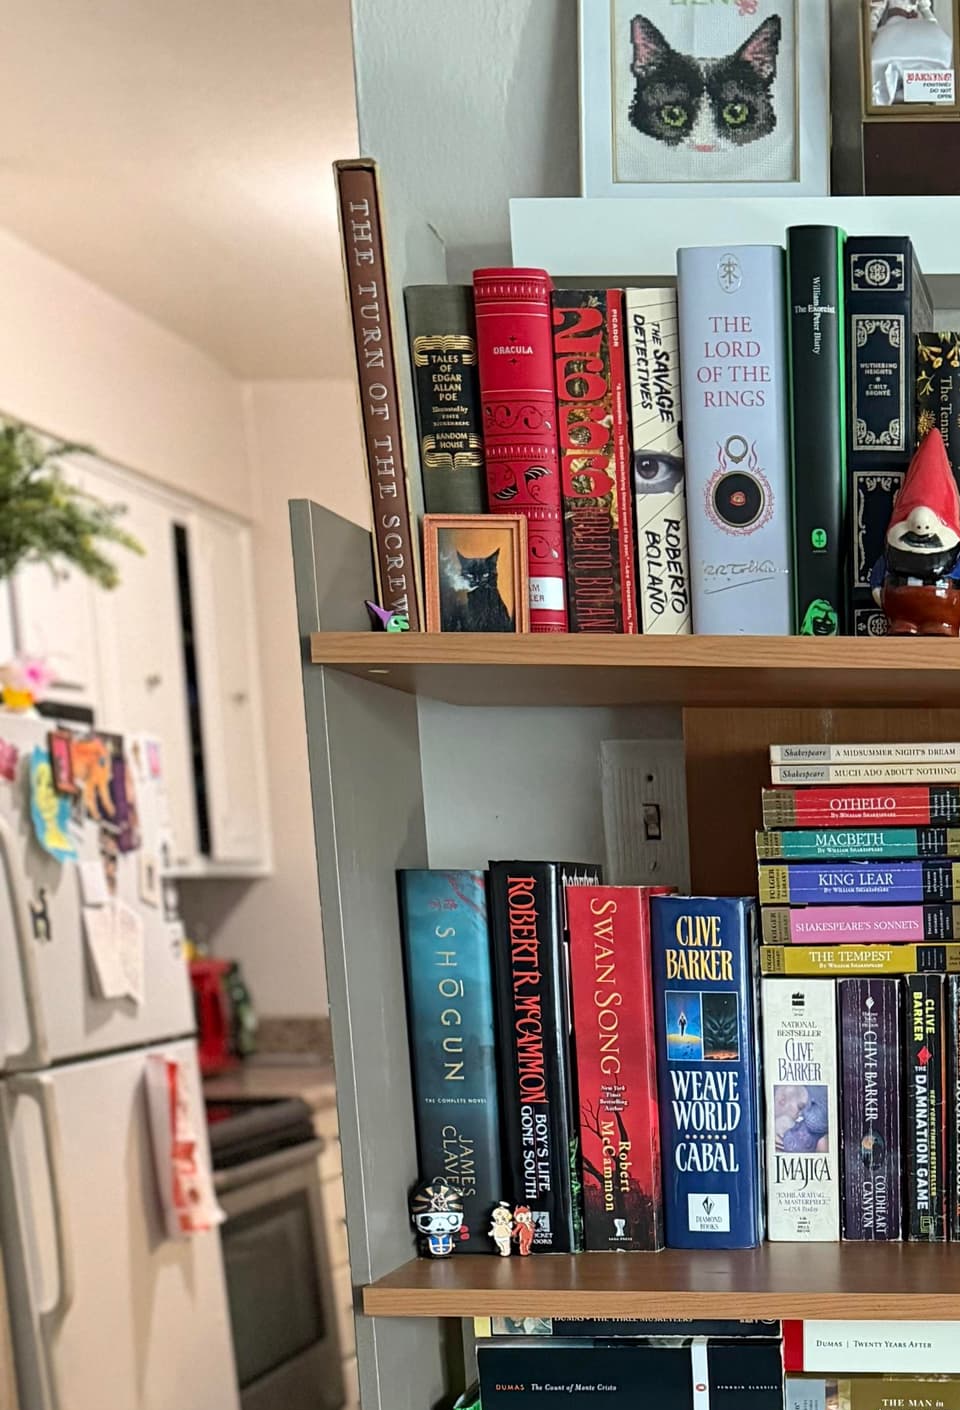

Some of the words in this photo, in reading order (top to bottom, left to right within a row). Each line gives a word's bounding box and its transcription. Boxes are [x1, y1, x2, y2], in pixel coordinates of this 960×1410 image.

[350, 199, 374, 266] THE
[358, 282, 384, 368] TURN
[652, 322, 661, 346] THE
[709, 317, 752, 333] THE
[432, 355, 459, 363] TALES
[493, 345, 534, 356] DRACULA
[634, 314, 652, 409] DETECTIVES
[704, 341, 761, 358] LORD
[653, 350, 674, 424] SAVAGE
[697, 365, 726, 383] OF
[731, 365, 771, 383] THE
[439, 392, 458, 401] POE
[704, 390, 765, 407] RINGS
[941, 376, 952, 401] The
[368, 384, 388, 421] OF
[553, 307, 615, 497] 2666
[374, 435, 397, 499] THE
[645, 531, 668, 614] BOLAÑO
[664, 519, 688, 614] ROBERTO
[784, 748, 827, 758] Shakespeare
[830, 798, 896, 811] OTHELLO
[816, 833, 884, 846] MACBETH
[819, 874, 854, 886] KING
[860, 873, 893, 885] LEAR
[590, 898, 617, 984] SWAN
[676, 916, 722, 947] CLIVE
[666, 950, 733, 981] BARKER
[809, 951, 836, 962] THE
[839, 951, 892, 961] TEMPEST
[594, 993, 622, 1075] SONG
[785, 1038, 814, 1062] CLIVE
[670, 1071, 739, 1100] WEAVE
[675, 1102, 741, 1130] WORLD
[619, 1141, 632, 1193] Robert
[676, 1143, 739, 1173] CABAL
[566, 1384, 573, 1392] of
[882, 1399, 905, 1407] THE
[909, 1399, 932, 1407] MAN
[935, 1399, 944, 1407] in
